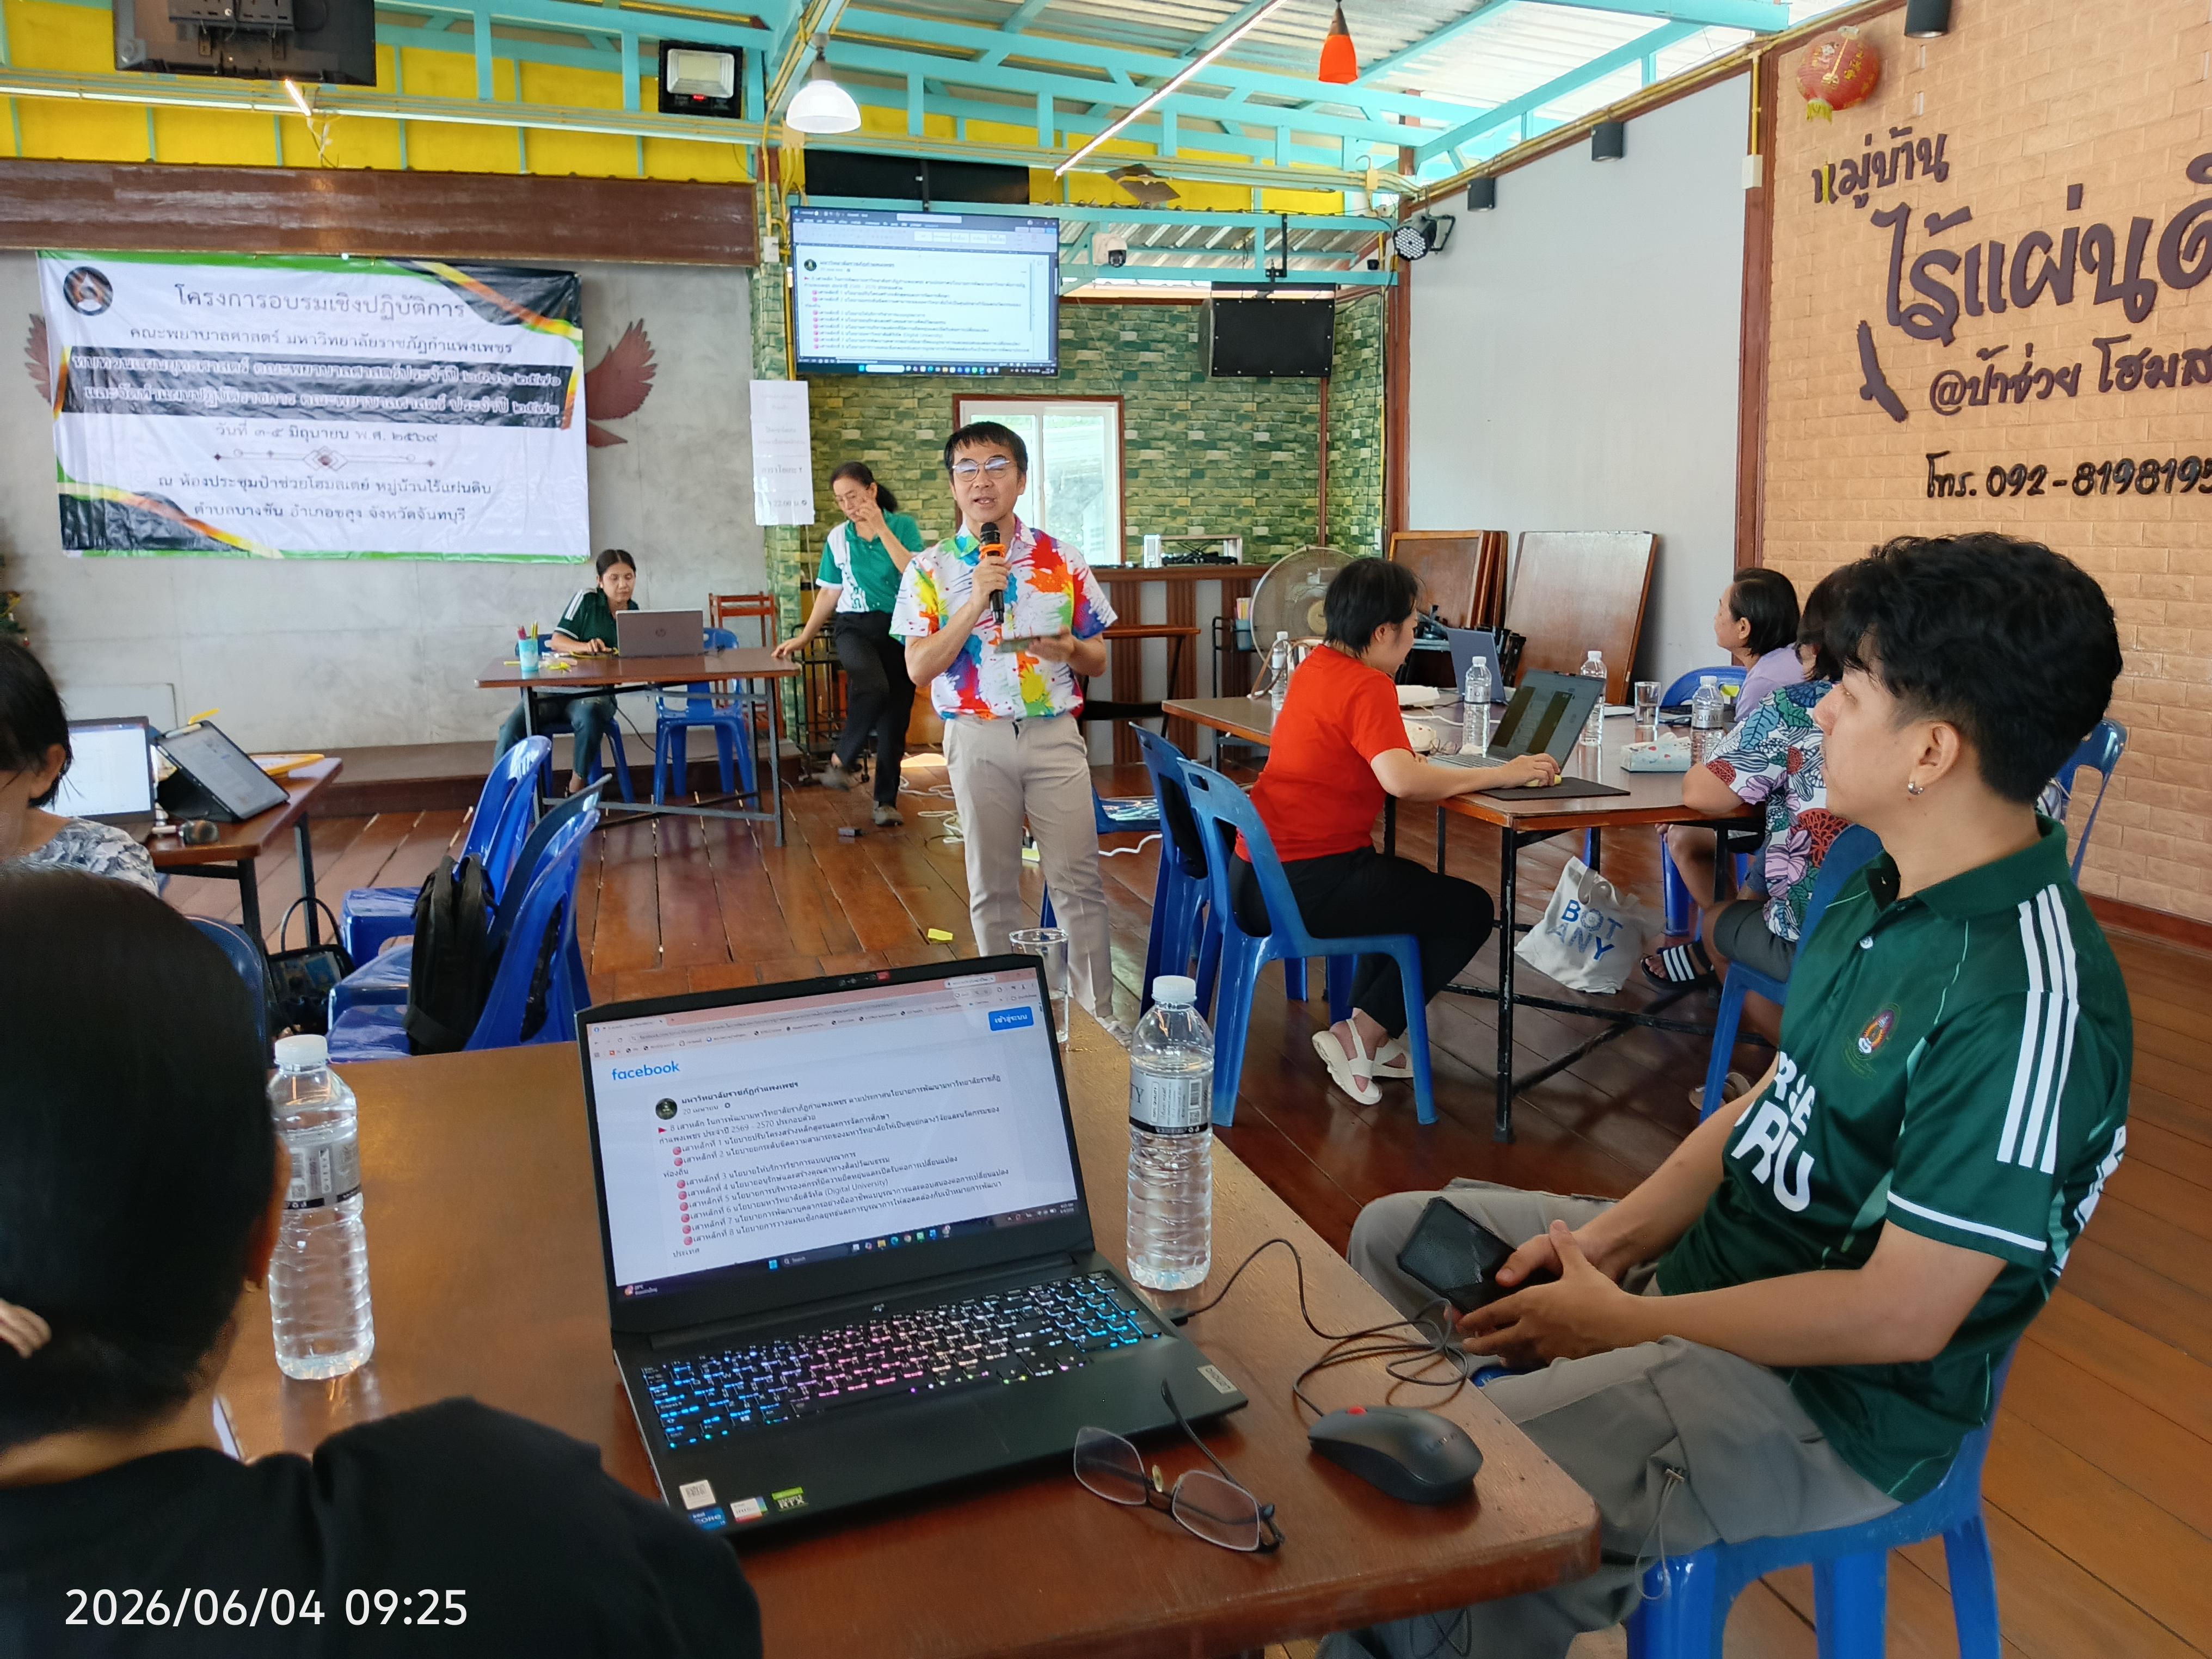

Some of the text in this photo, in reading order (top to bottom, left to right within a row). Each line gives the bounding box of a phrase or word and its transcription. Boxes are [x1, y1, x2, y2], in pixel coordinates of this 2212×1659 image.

[174, 283, 465, 322] โครงการอบรมเชิงปฏิบัติการ
[130, 327, 281, 345] คณะพยาบาลศาสตร์
[289, 425, 350, 443] มิถุนายน
[612, 1060, 680, 1080] facebook
[1731, 1099, 1815, 1212] RU
